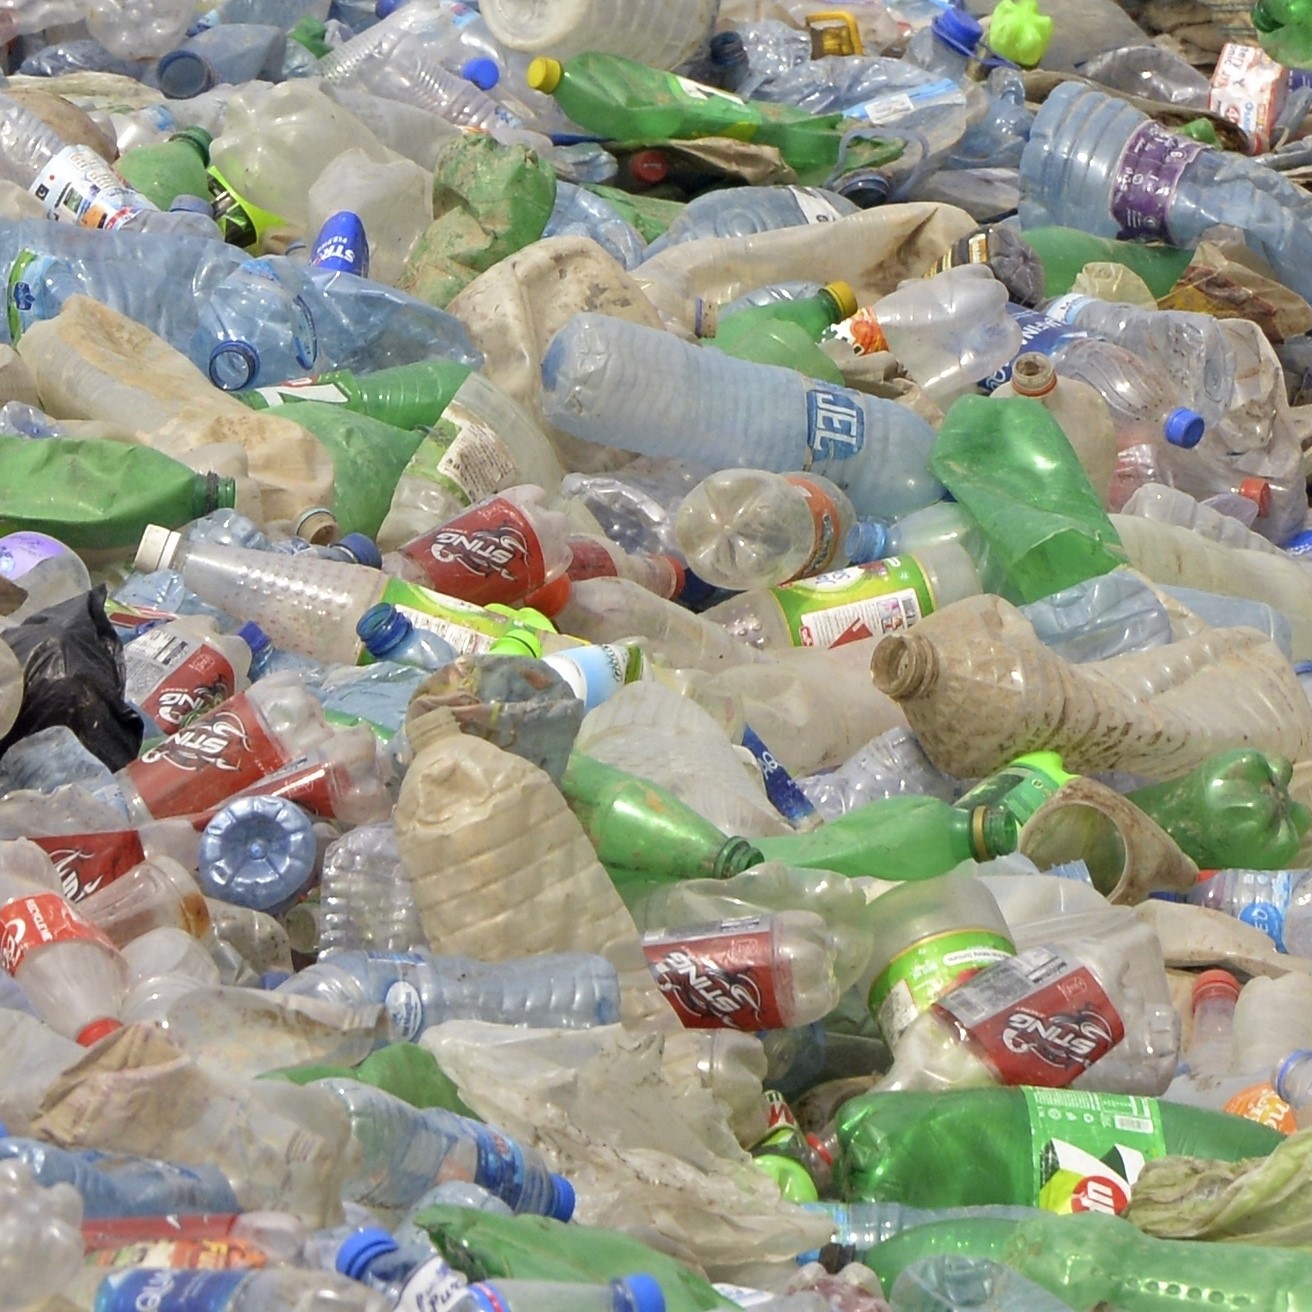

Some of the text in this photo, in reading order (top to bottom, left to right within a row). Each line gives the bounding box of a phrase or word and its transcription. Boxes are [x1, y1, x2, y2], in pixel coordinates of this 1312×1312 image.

[435, 533, 513, 564] STING
[665, 950, 744, 1014] STING
[1005, 1011, 1098, 1058] STING
